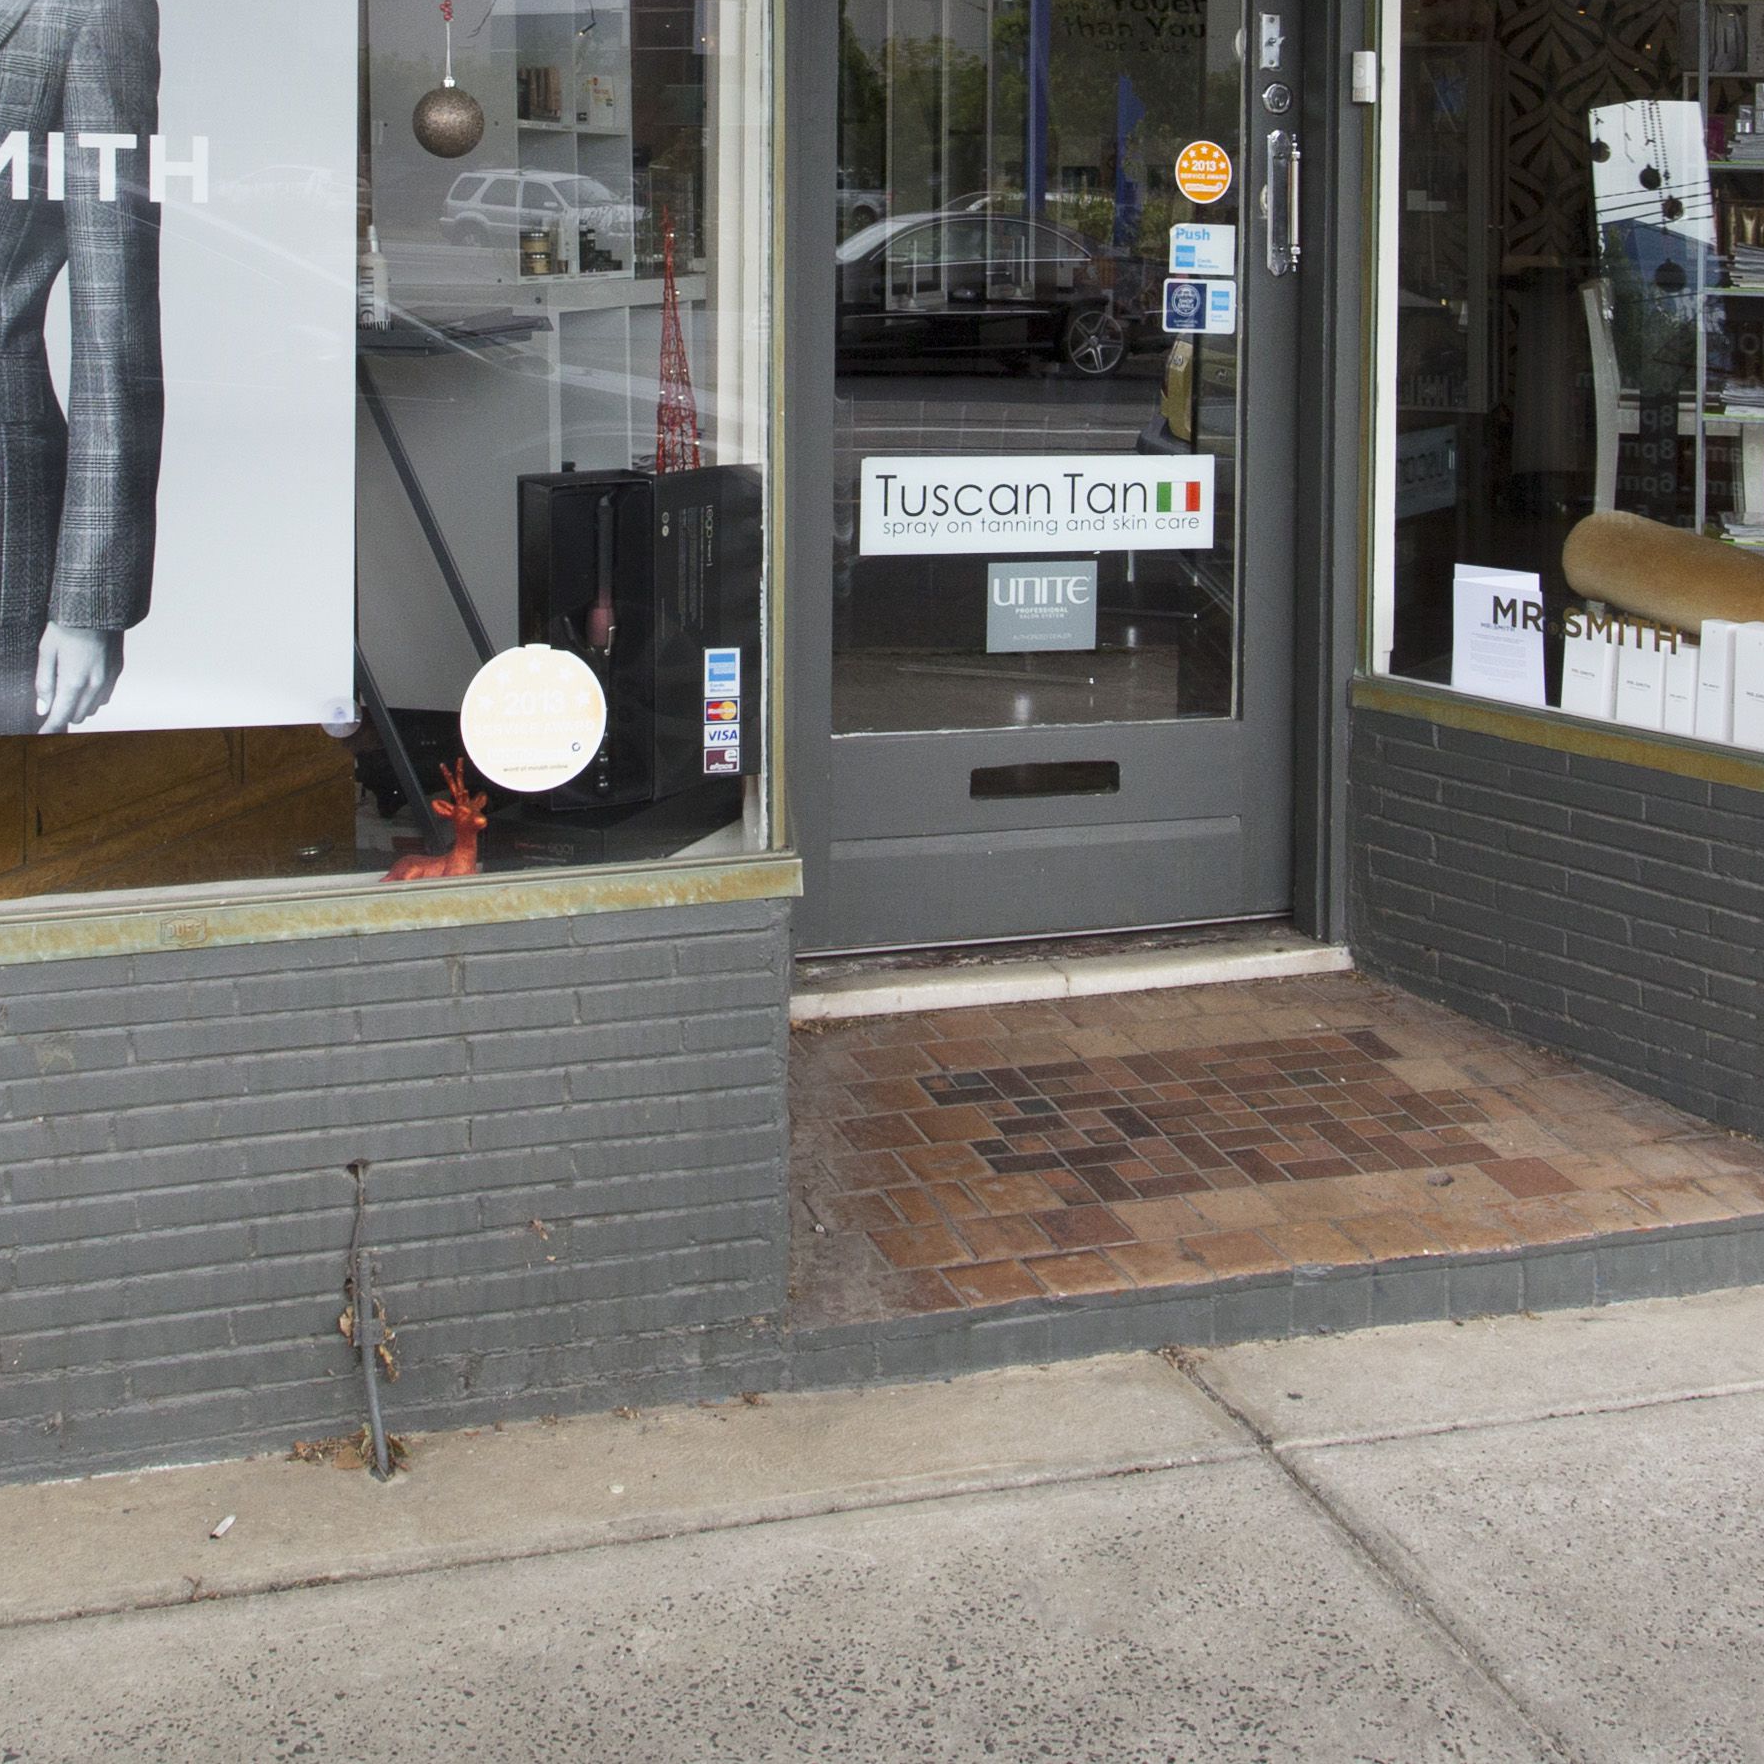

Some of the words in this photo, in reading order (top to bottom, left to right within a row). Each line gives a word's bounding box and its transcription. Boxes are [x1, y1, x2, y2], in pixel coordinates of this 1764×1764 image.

[1191, 160, 1216, 172] 2013
[1176, 227, 1211, 241] Push
[875, 474, 1051, 517] Tuscan
[1063, 473, 1147, 515] Tan
[883, 518, 938, 537] spray
[947, 520, 972, 534] on
[980, 516, 1057, 536] tanning
[1066, 514, 1105, 532] and
[1112, 514, 1147, 531] skin
[1154, 515, 1200, 530] care
[1563, 607, 1678, 655] SMITH
[502, 687, 566, 716] 2013
[708, 729, 738, 742] VISA
